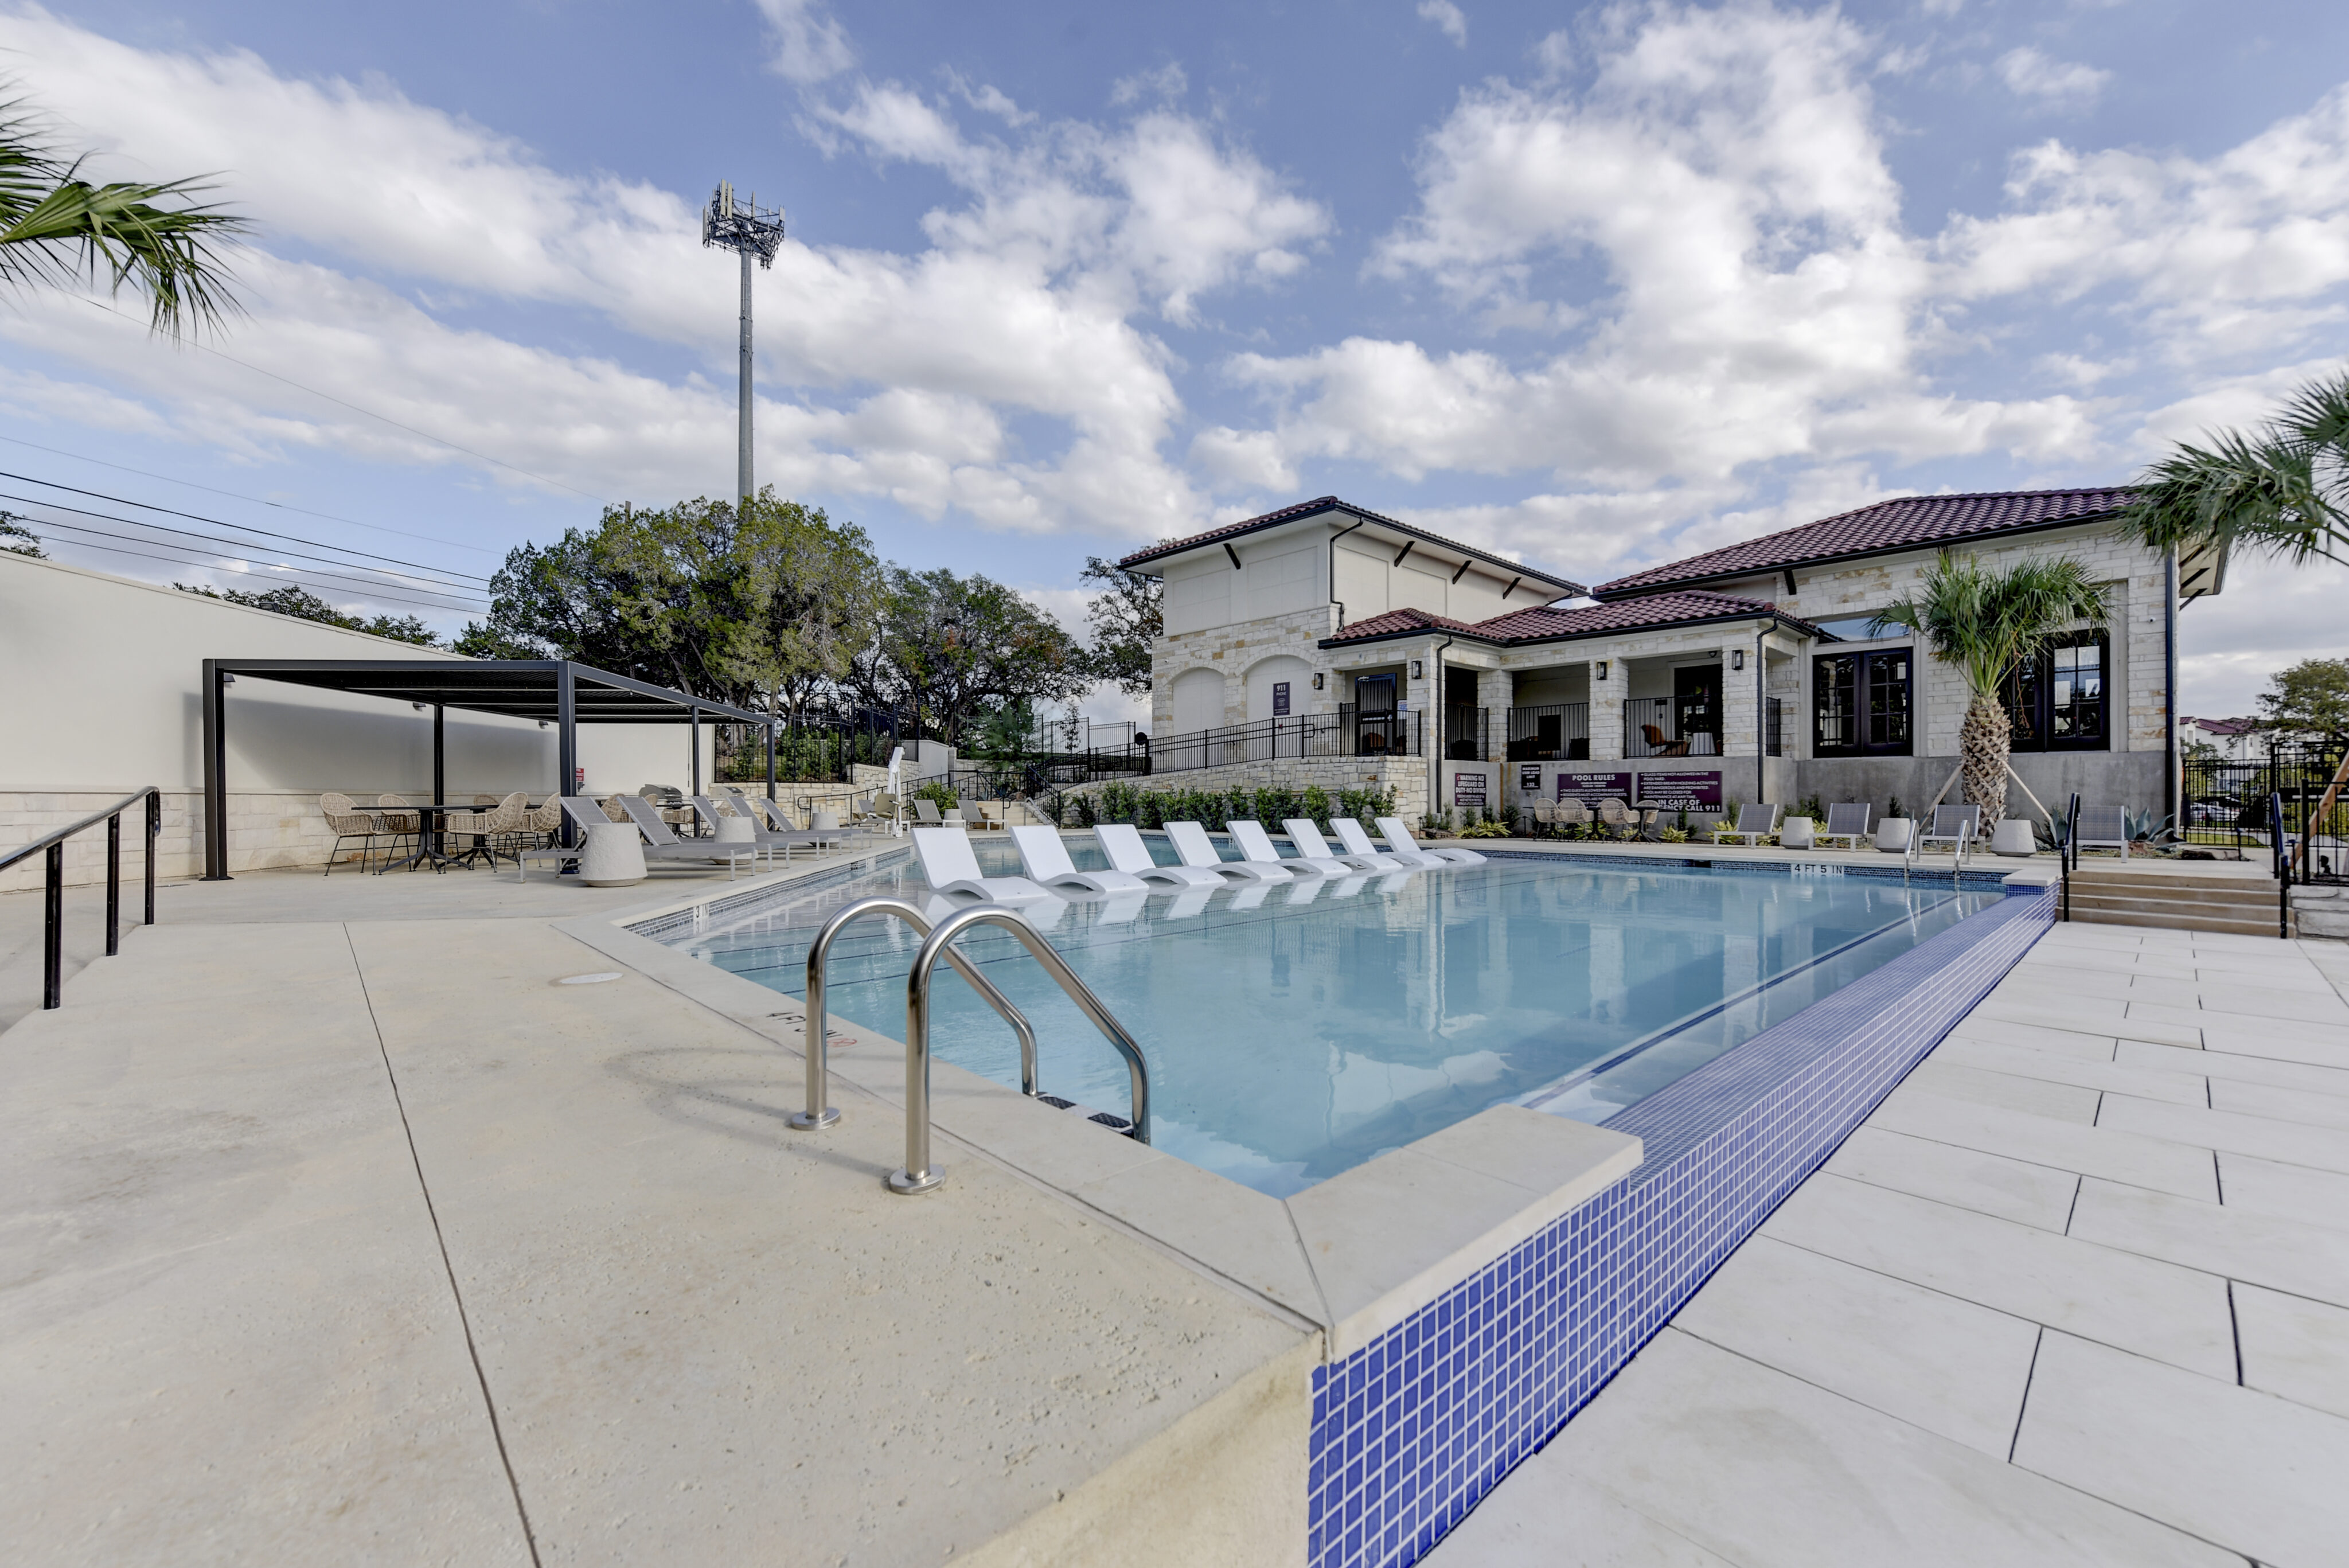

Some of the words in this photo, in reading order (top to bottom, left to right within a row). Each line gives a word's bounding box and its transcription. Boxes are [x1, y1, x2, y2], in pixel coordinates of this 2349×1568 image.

[1795, 864, 1801, 872] 4
[1805, 864, 1816, 872] FT
[1821, 865, 1827, 873] 5
[1832, 865, 1842, 873] IN
[696, 906, 700, 918] 3
[702, 903, 708, 916] IN
